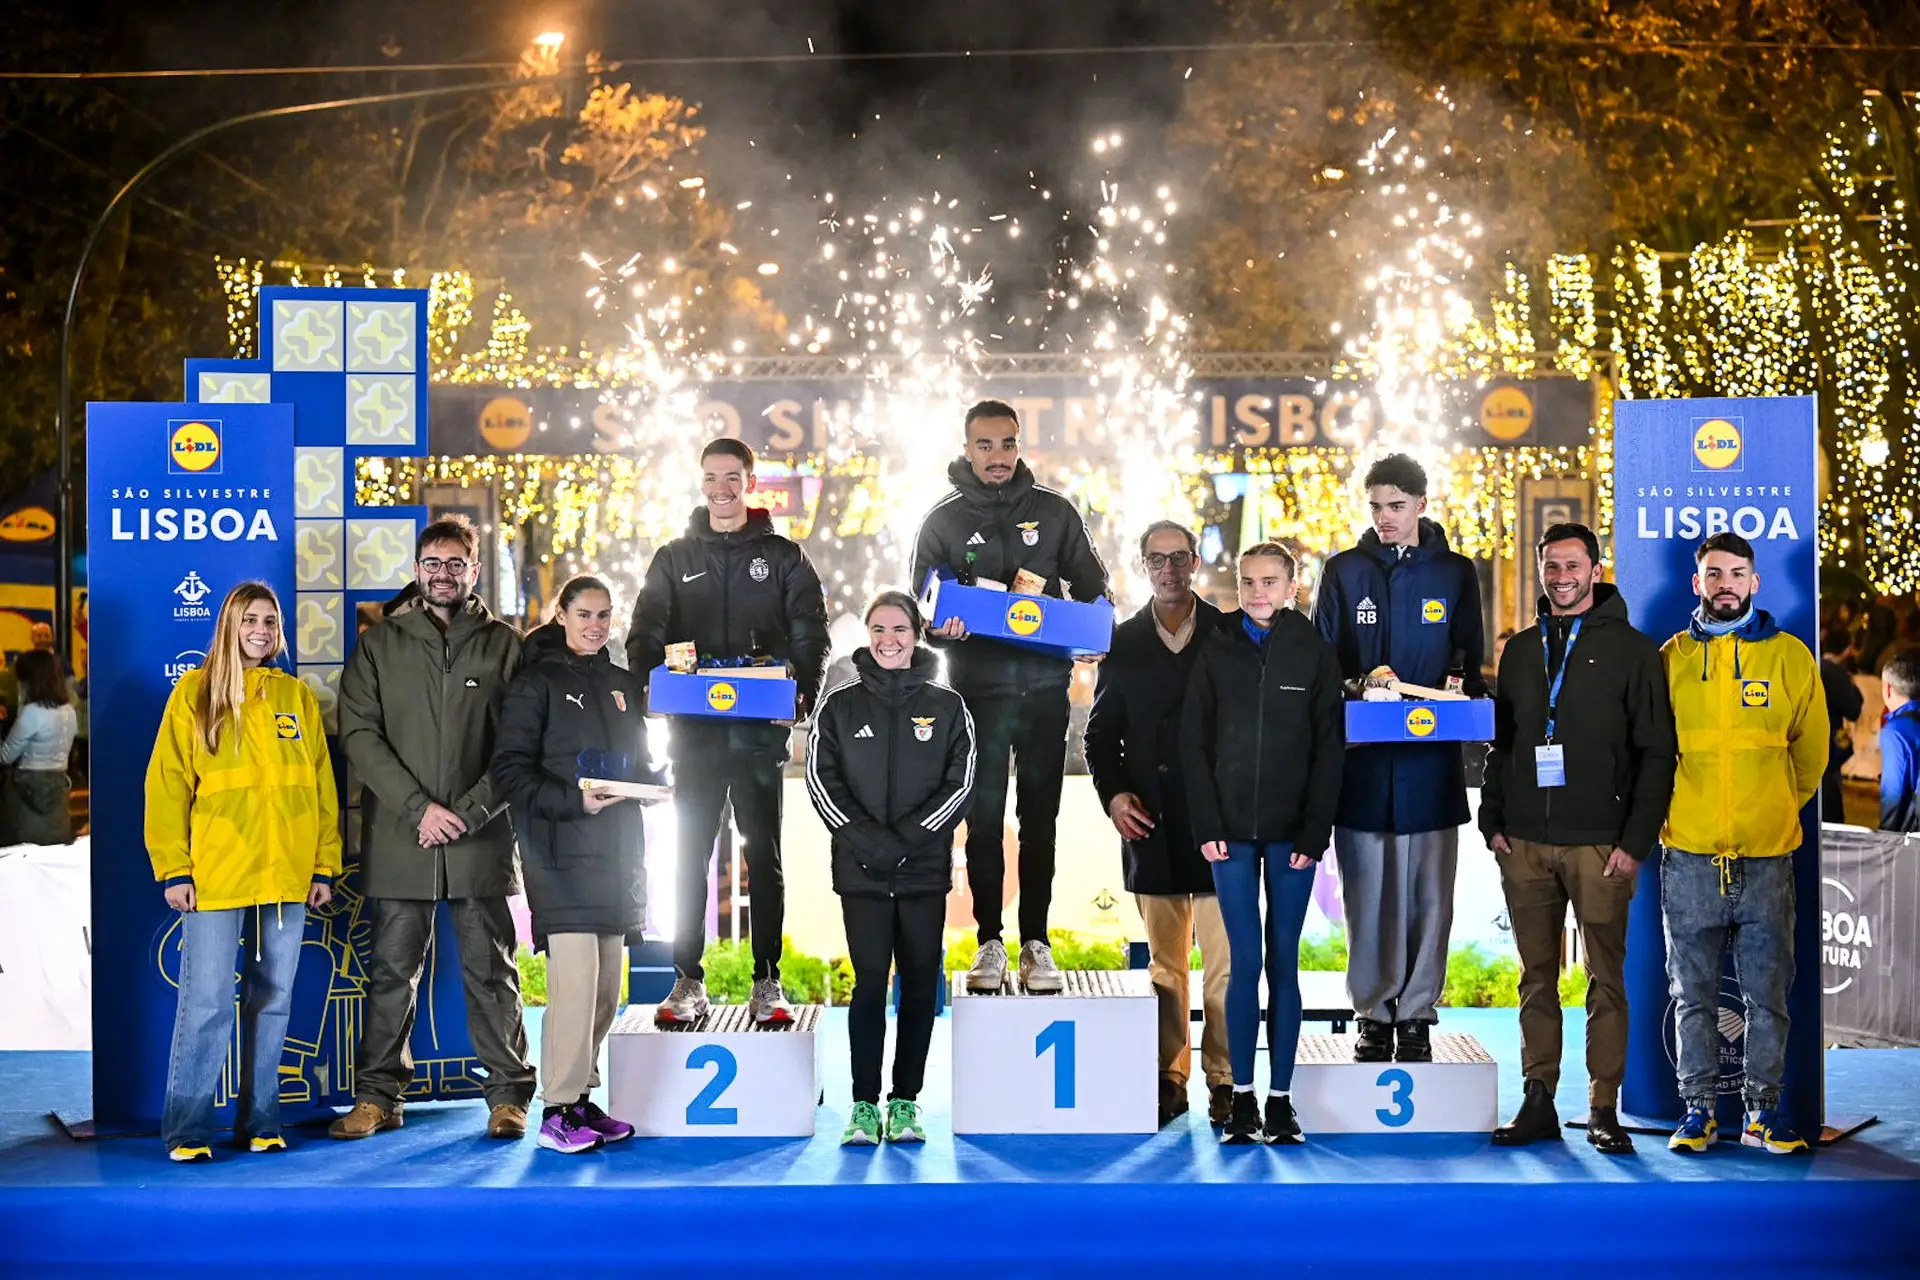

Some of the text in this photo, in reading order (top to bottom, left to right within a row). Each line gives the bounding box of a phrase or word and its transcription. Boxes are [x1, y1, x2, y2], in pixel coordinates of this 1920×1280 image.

[112, 487, 271, 499] SÃO SILVESTRE
[1638, 485, 1792, 498] SÃO SILVESTRE
[111, 507, 278, 542] LISBOA
[1637, 506, 1799, 540] LISBOA
[173, 607, 211, 617] LISBOA
[1356, 611, 1377, 625] RB
[1822, 910, 1872, 948] BOA
[1035, 1020, 1076, 1109] 1
[685, 1044, 738, 1125] 2
[1375, 1068, 1415, 1127] 3
